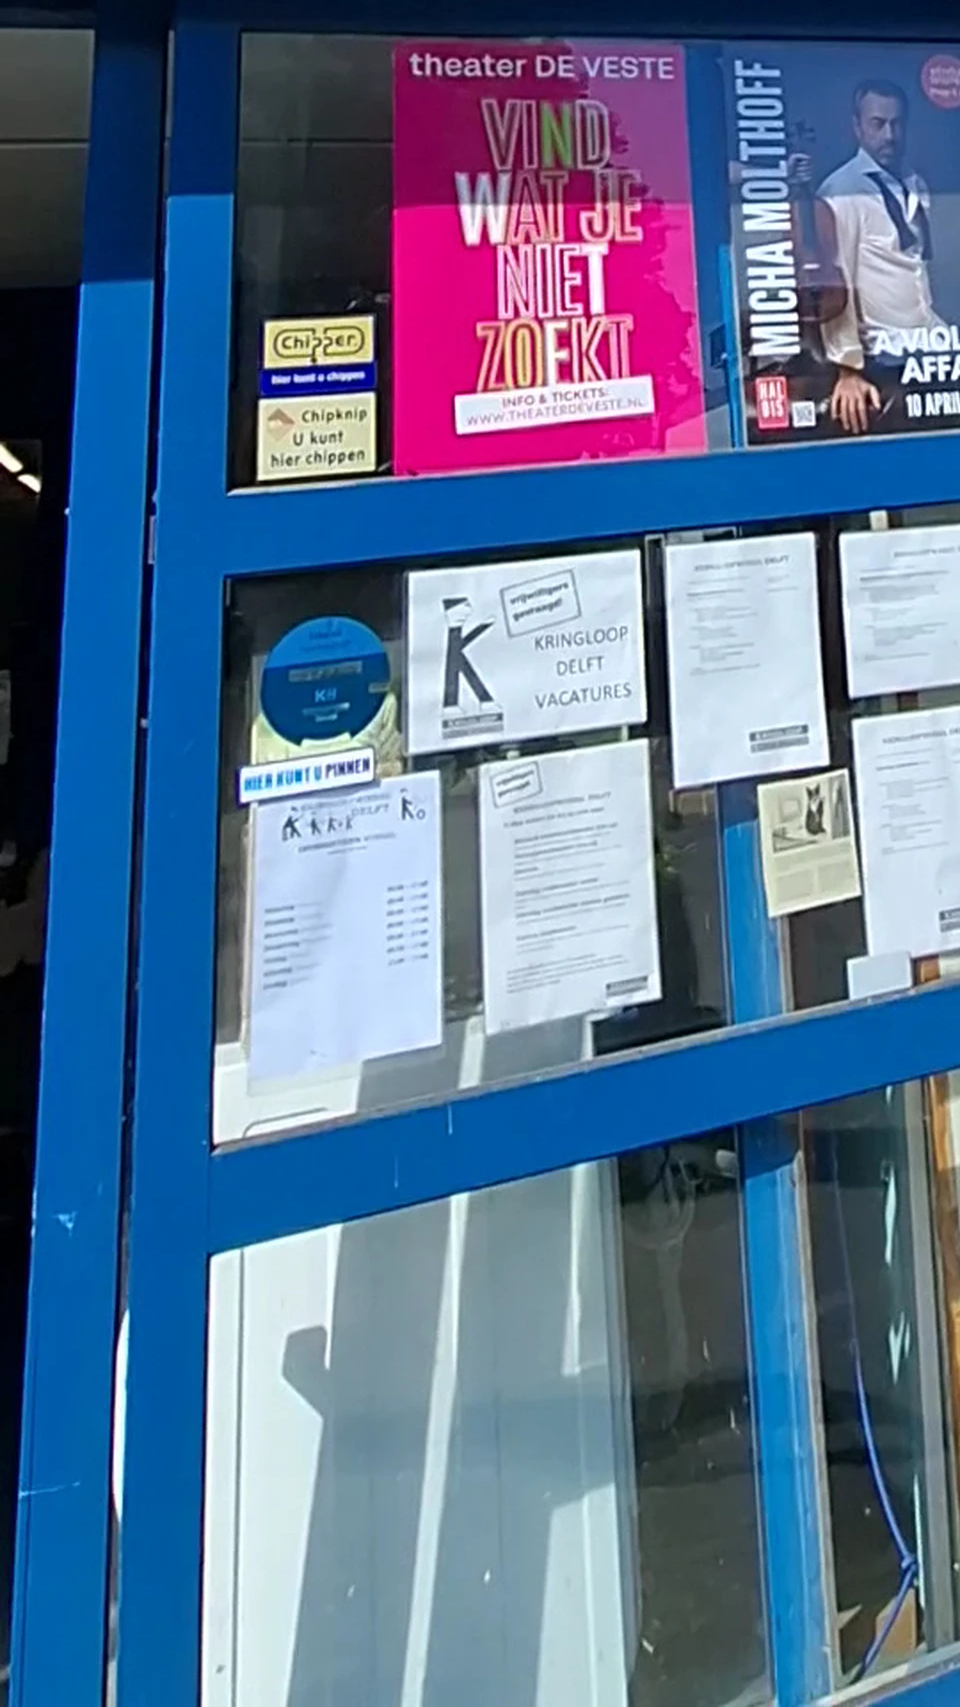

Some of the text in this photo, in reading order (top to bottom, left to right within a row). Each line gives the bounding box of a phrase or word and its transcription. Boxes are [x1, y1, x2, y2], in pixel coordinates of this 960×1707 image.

[408, 53, 676, 80] theater DE VESTE
[481, 98, 612, 170] VIND
[454, 169, 644, 247] WAT JE
[734, 59, 801, 357] MICHA MOLTHOFF
[496, 243, 610, 320] NIET
[476, 313, 634, 394] ZOEKT
[872, 329, 903, 357] A
[467, 396, 645, 427] WWW.THEATERDEVESTE.NL
[501, 395, 535, 408] INFO
[538, 395, 548, 405] &
[905, 393, 923, 418] 10
[301, 408, 368, 424] Chipknip
[292, 430, 344, 446] U kunt
[270, 449, 366, 467] hier chippen
[534, 625, 629, 652] KRINGLOOP
[556, 655, 605, 677] DELFT
[535, 681, 633, 710] VACATURES
[244, 756, 371, 792] HIER KUNT U PINNEN
